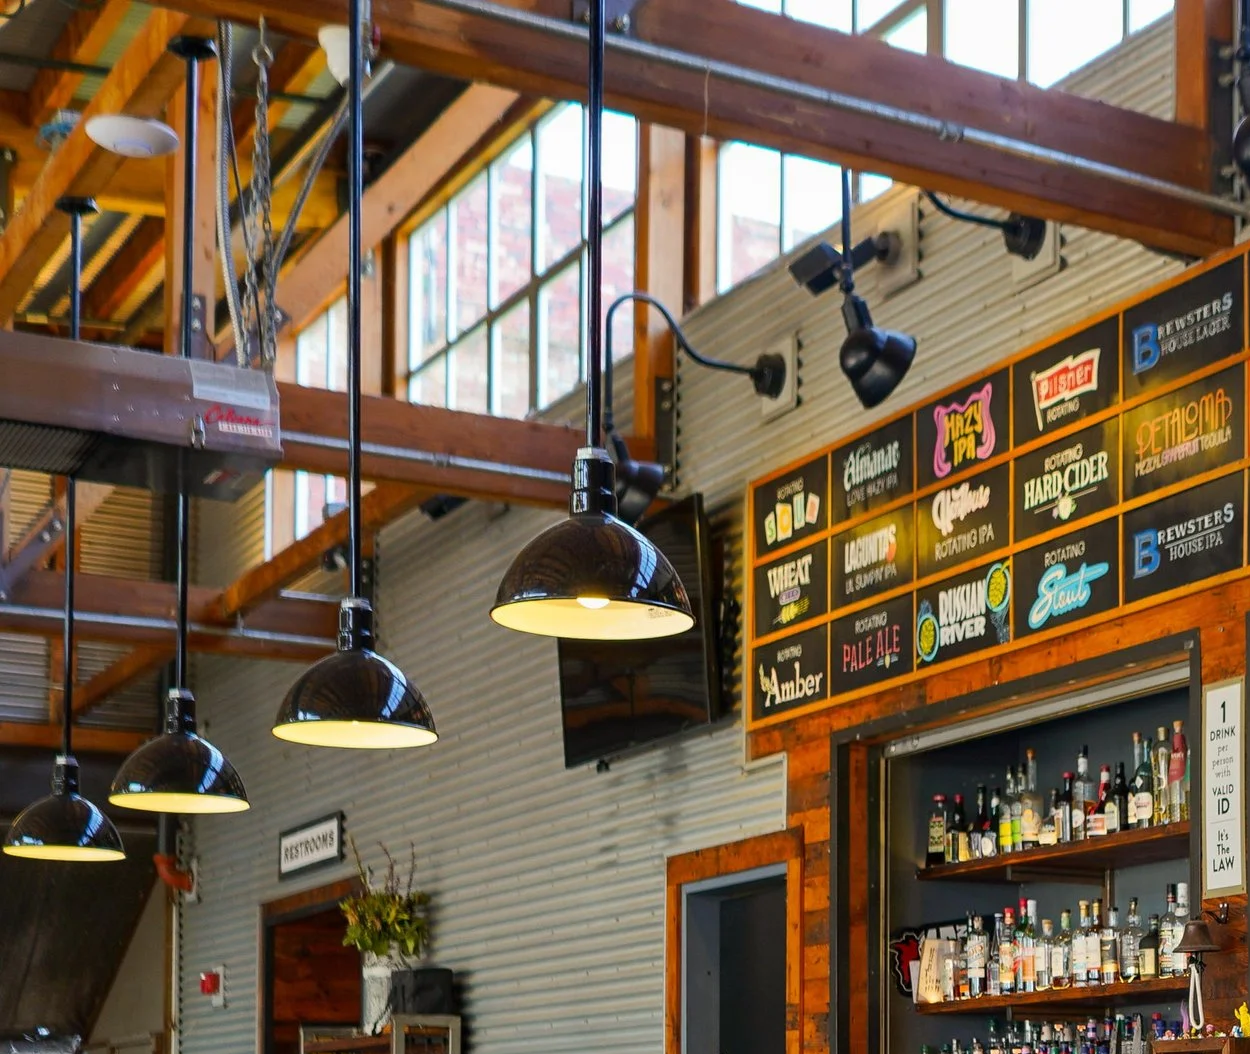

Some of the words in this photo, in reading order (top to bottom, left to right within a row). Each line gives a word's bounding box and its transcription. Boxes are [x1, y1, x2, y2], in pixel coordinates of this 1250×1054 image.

[1132, 291, 1233, 376] BREWSTERS
[1160, 331, 1195, 356] HOUSE
[1038, 363, 1093, 400] Pilsner
[943, 400, 983, 448] HAZY
[1046, 398, 1080, 424] ROTATING
[953, 432, 976, 467] IPA
[1044, 443, 1083, 472] ROTATING
[1023, 470, 1062, 511] HARD
[1063, 451, 1109, 491] CIDER
[934, 528, 978, 562] ROTATING
[978, 522, 995, 545] IPA
[1044, 540, 1086, 568] ROTATING
[1132, 502, 1234, 579] BREWSTERS
[1169, 534, 1205, 562] HOUSE
[1205, 530, 1224, 551] IPA
[767, 553, 812, 598] WHEAT
[938, 578, 987, 626] RUSSIAN
[1030, 563, 1108, 626] Stout
[855, 611, 887, 635] ROTATING
[939, 618, 987, 647] RIVER
[842, 635, 873, 673] PALE
[876, 624, 900, 654] ALE
[765, 660, 824, 707] Amber
[1220, 701, 1227, 724] 1
[1209, 725, 1236, 742] DRINK
[1212, 756, 1234, 770] person
[1217, 743, 1229, 757] per
[1214, 767, 1232, 779] with
[1212, 783, 1235, 796] VALID
[1217, 797, 1230, 816] ID
[283, 829, 335, 864] RESTROOMS
[1216, 843, 1230, 855] The
[1217, 829, 1229, 842] It's
[1212, 855, 1235, 873] LAW
